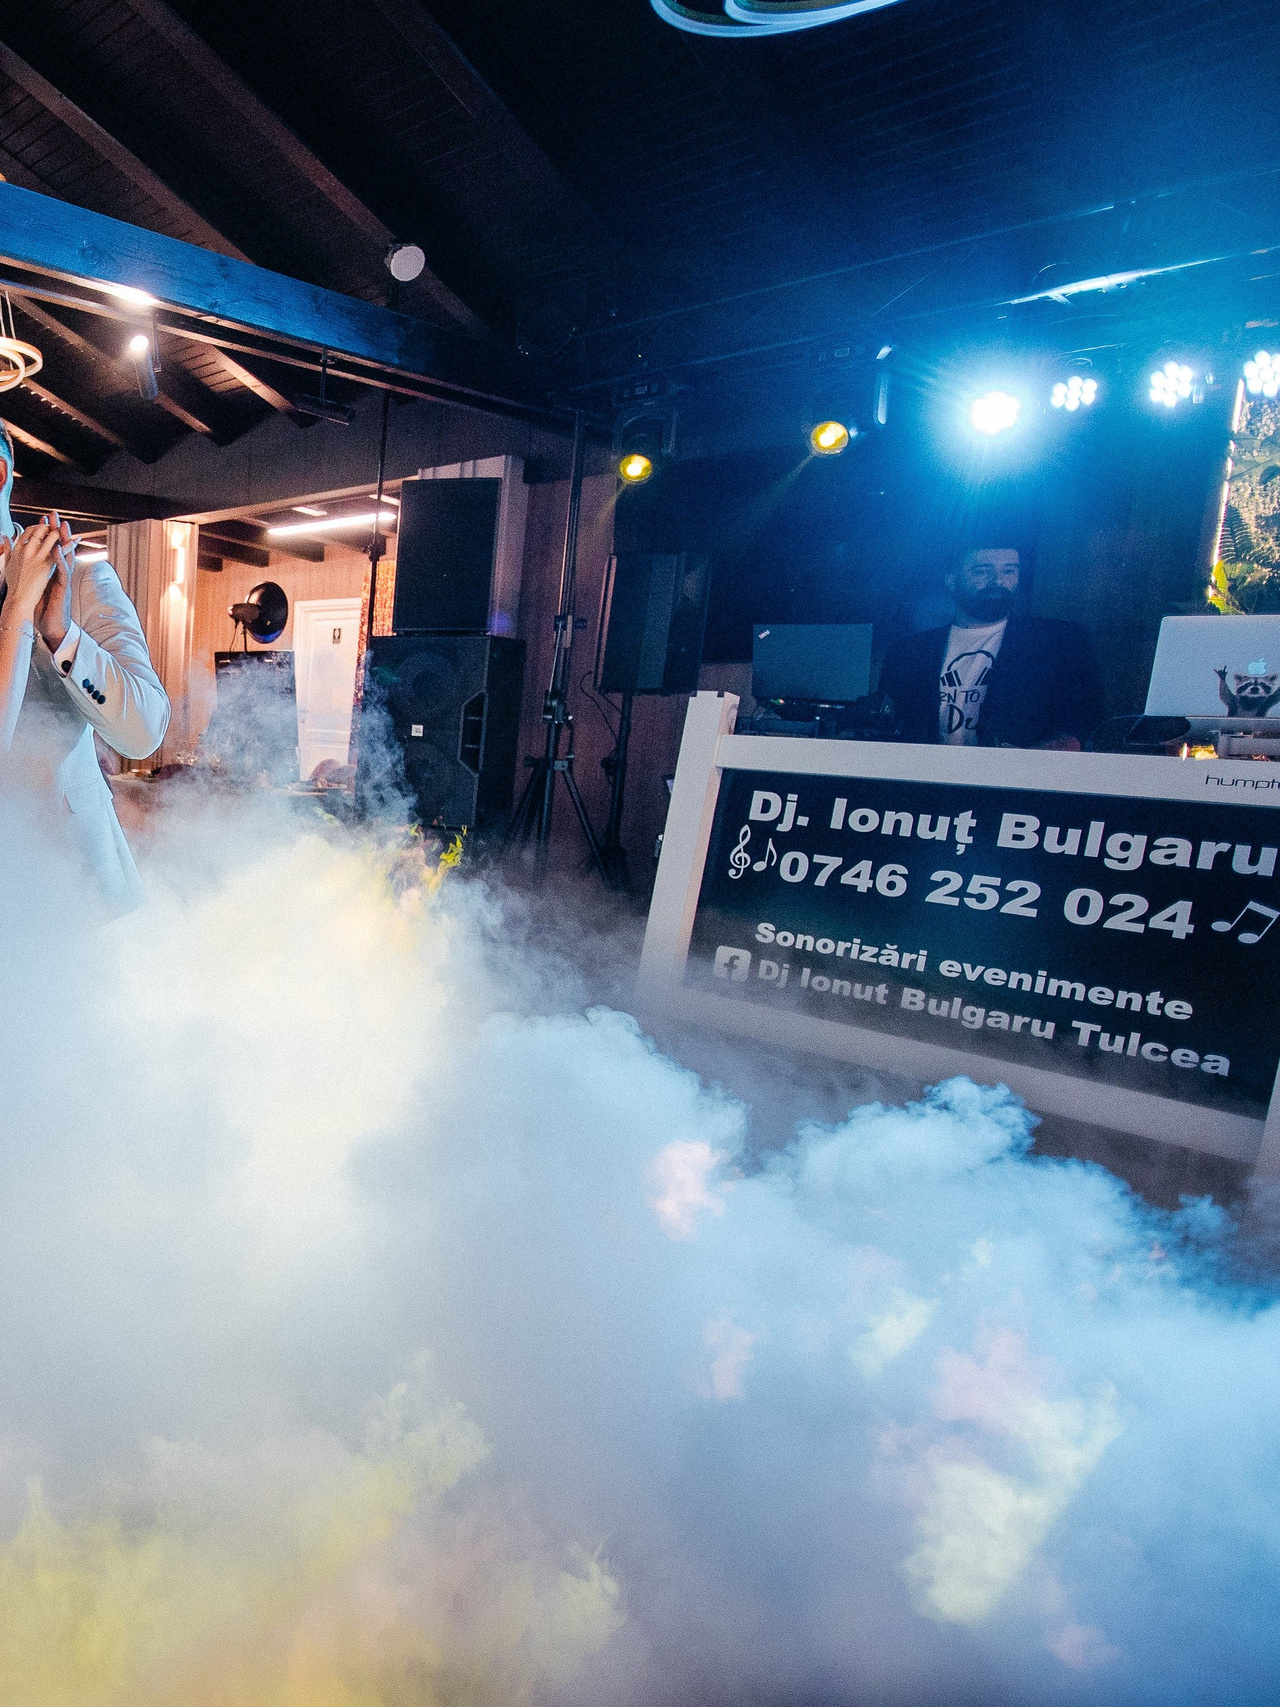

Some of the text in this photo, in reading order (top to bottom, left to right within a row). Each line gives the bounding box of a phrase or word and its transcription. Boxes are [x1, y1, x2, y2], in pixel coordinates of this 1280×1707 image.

[960, 689, 980, 704] TO
[749, 790, 1278, 876] Dj. Ionuț Bulgaru
[779, 851, 1195, 940] 0746 252 024
[755, 922, 1193, 1020] Sonorizări evenimente
[758, 959, 790, 989] Dj
[800, 967, 889, 1005] Ionut
[900, 987, 1056, 1040] Bulgaru
[1072, 1020, 1231, 1077] Tulcea
